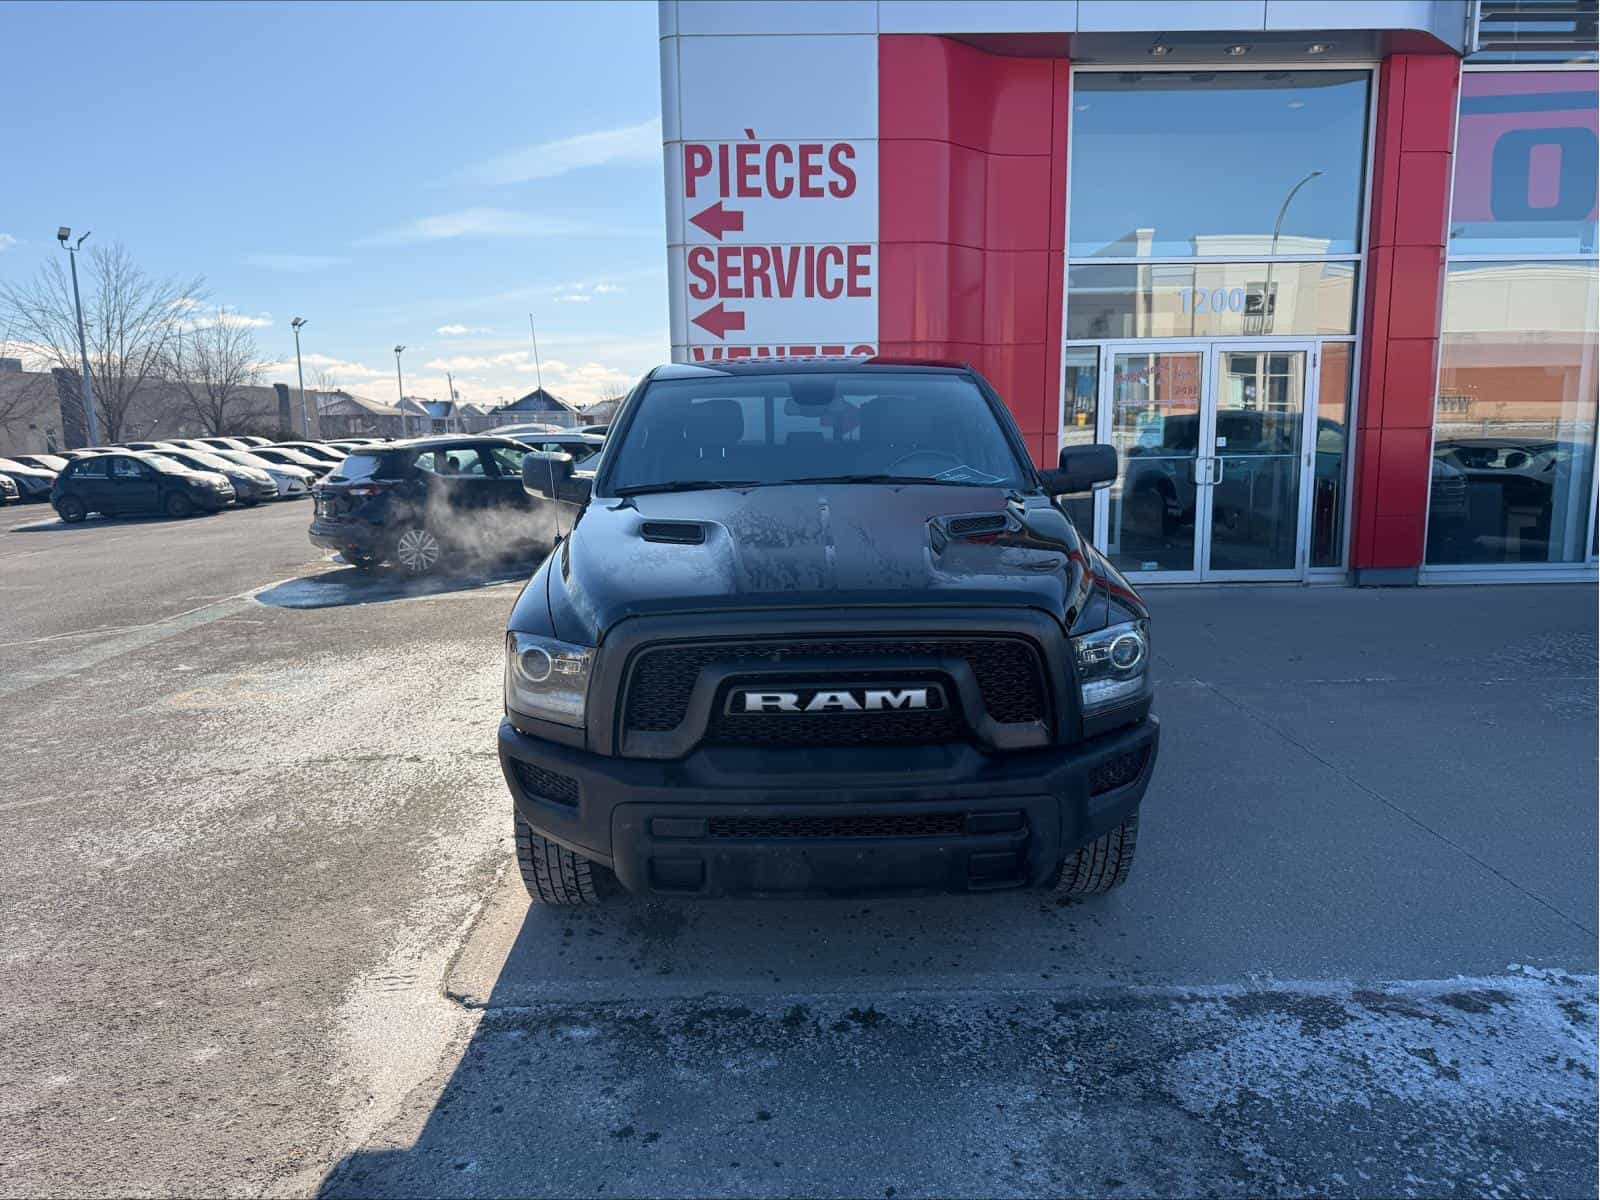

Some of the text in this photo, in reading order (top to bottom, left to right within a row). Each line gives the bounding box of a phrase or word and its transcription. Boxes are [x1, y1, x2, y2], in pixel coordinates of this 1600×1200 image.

[684, 128, 857, 199] PIÈCES
[687, 245, 872, 300] SERVICE
[1178, 287, 1246, 314] 1200
[745, 688, 928, 712] RAM
